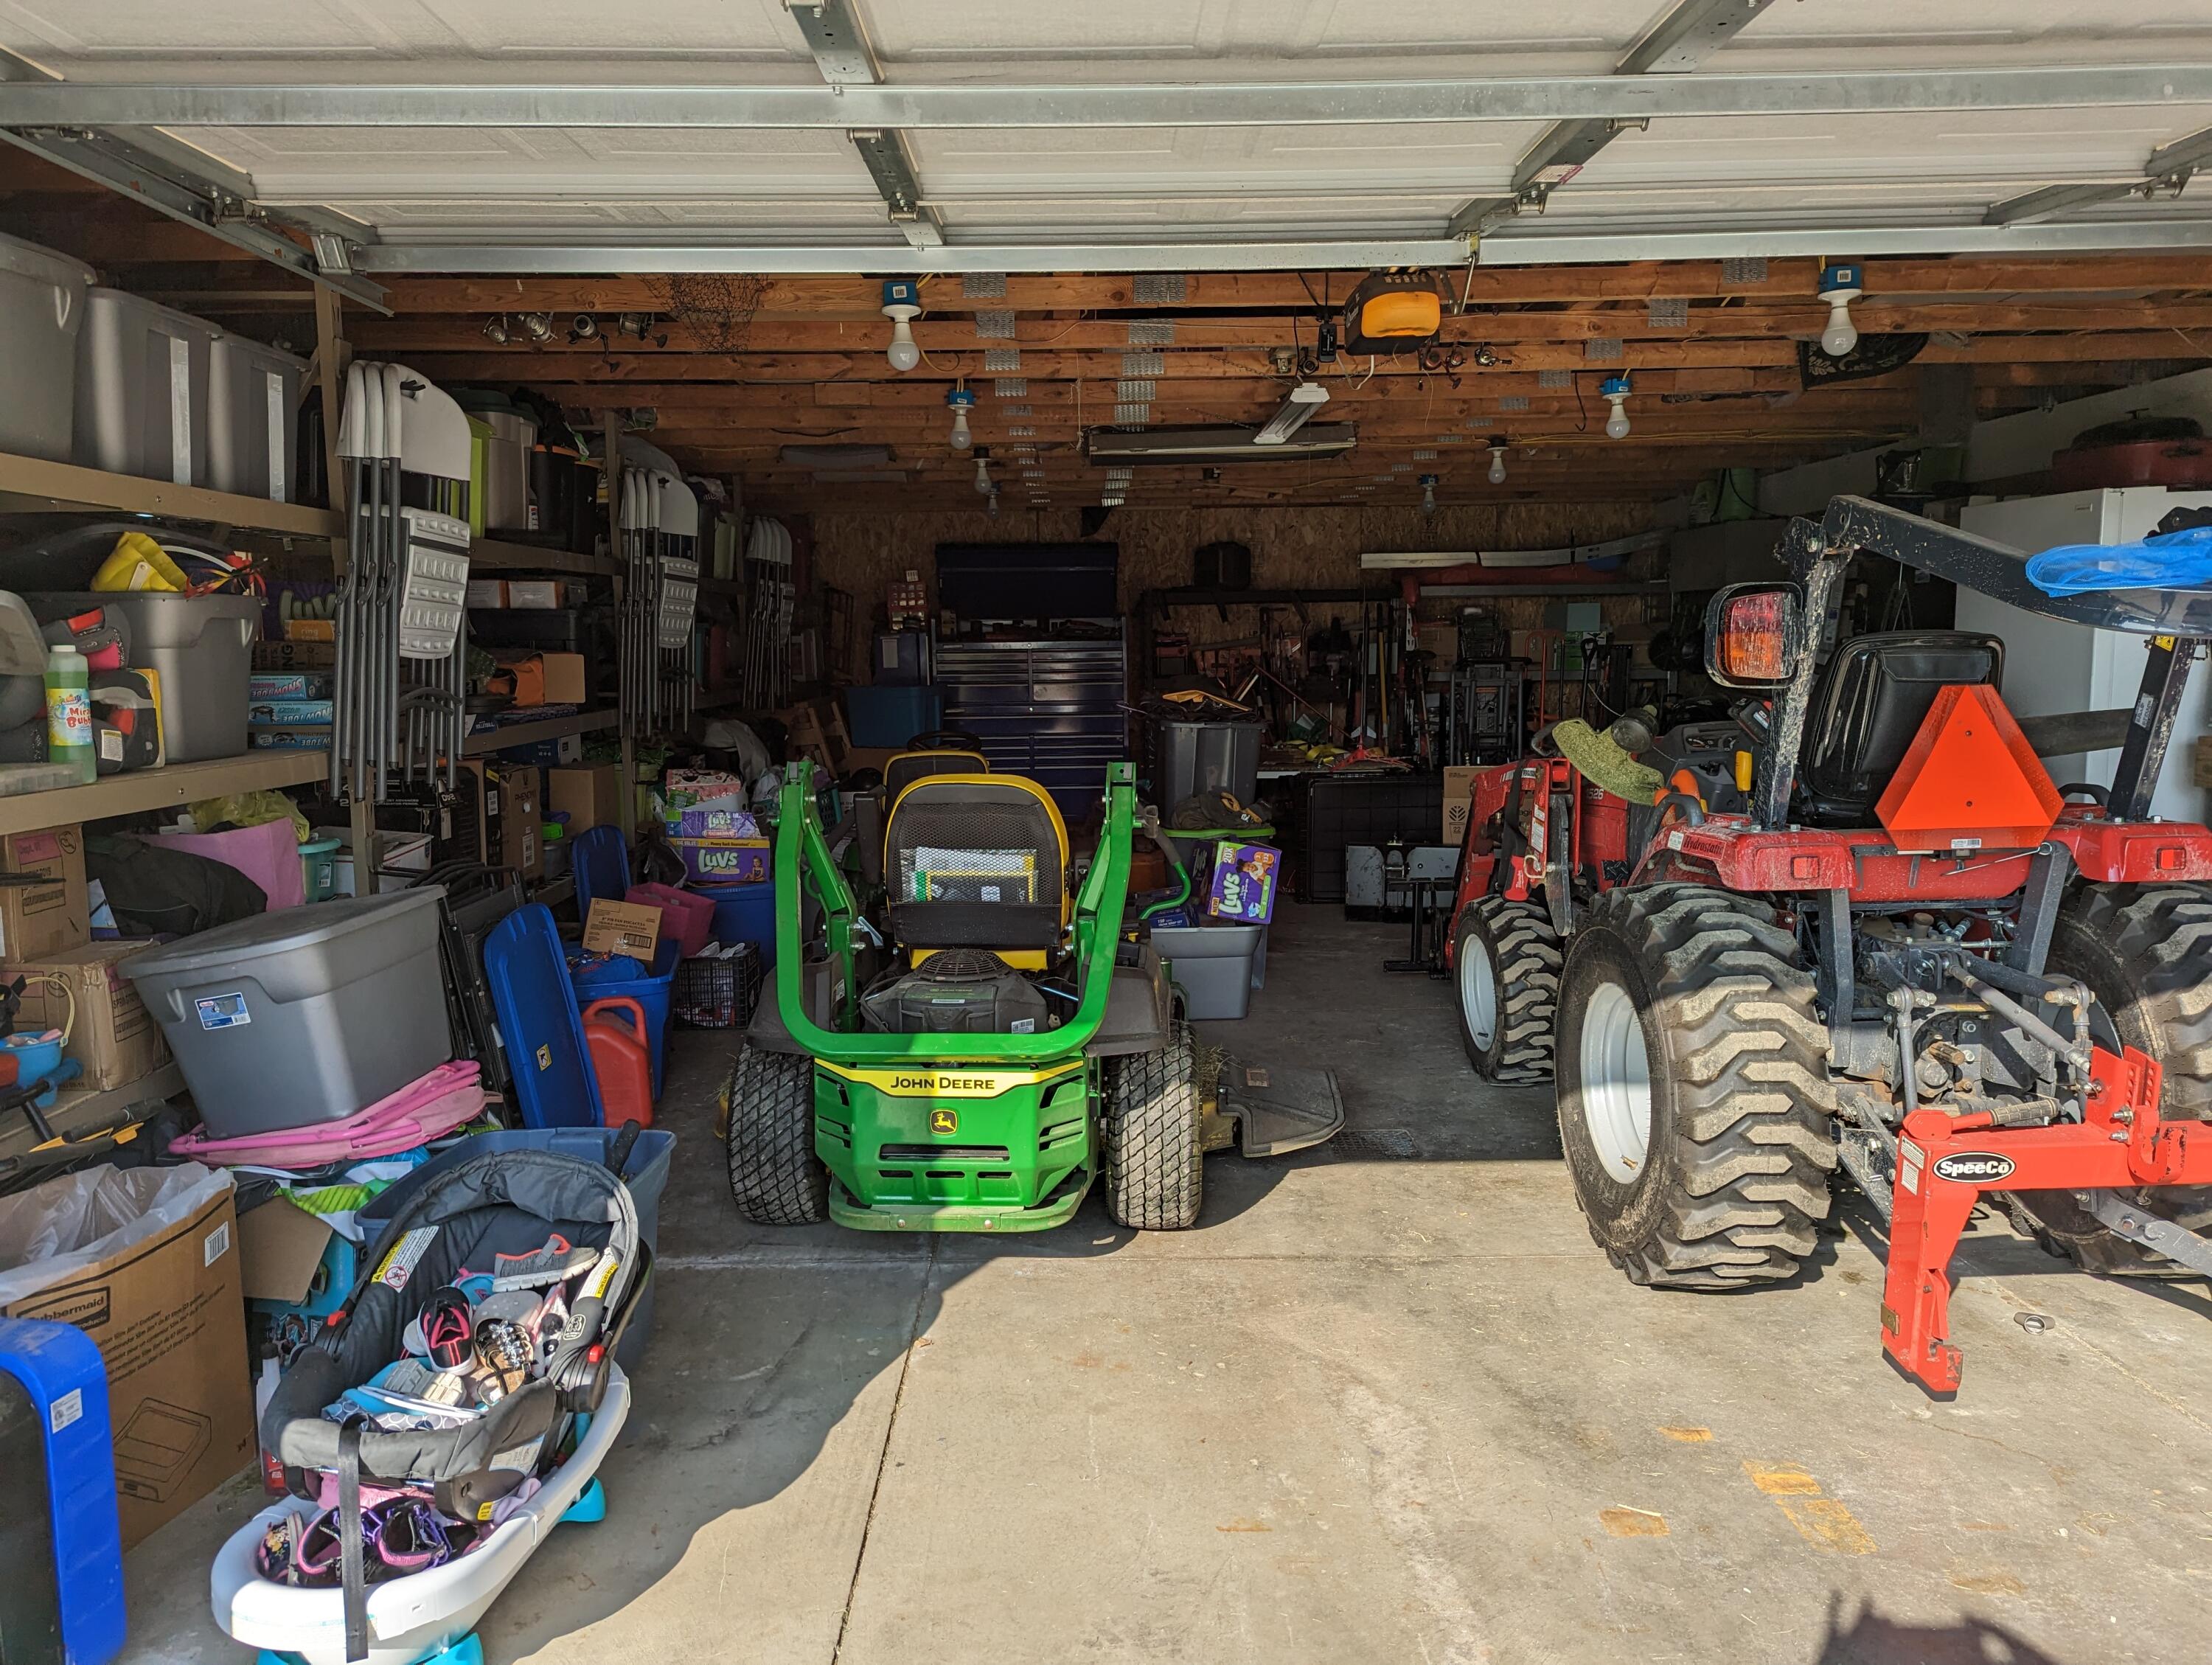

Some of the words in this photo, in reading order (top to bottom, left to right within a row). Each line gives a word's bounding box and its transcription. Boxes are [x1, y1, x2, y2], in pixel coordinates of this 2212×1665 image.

[301, 628, 319, 636] ring
[274, 677, 302, 695] SNOW
[69, 707, 91, 716] Mira
[66, 716, 91, 728] Bubb
[709, 814, 731, 828] Luvs
[1683, 835, 1724, 855] Hydrostatic
[699, 849, 738, 872] Luvs
[1223, 847, 1234, 863] 20X
[1219, 872, 1243, 914] Luvs
[890, 1076, 935, 1089] JOHN
[939, 1077, 995, 1089] DEERE
[78, 1315, 108, 1329] roducts
